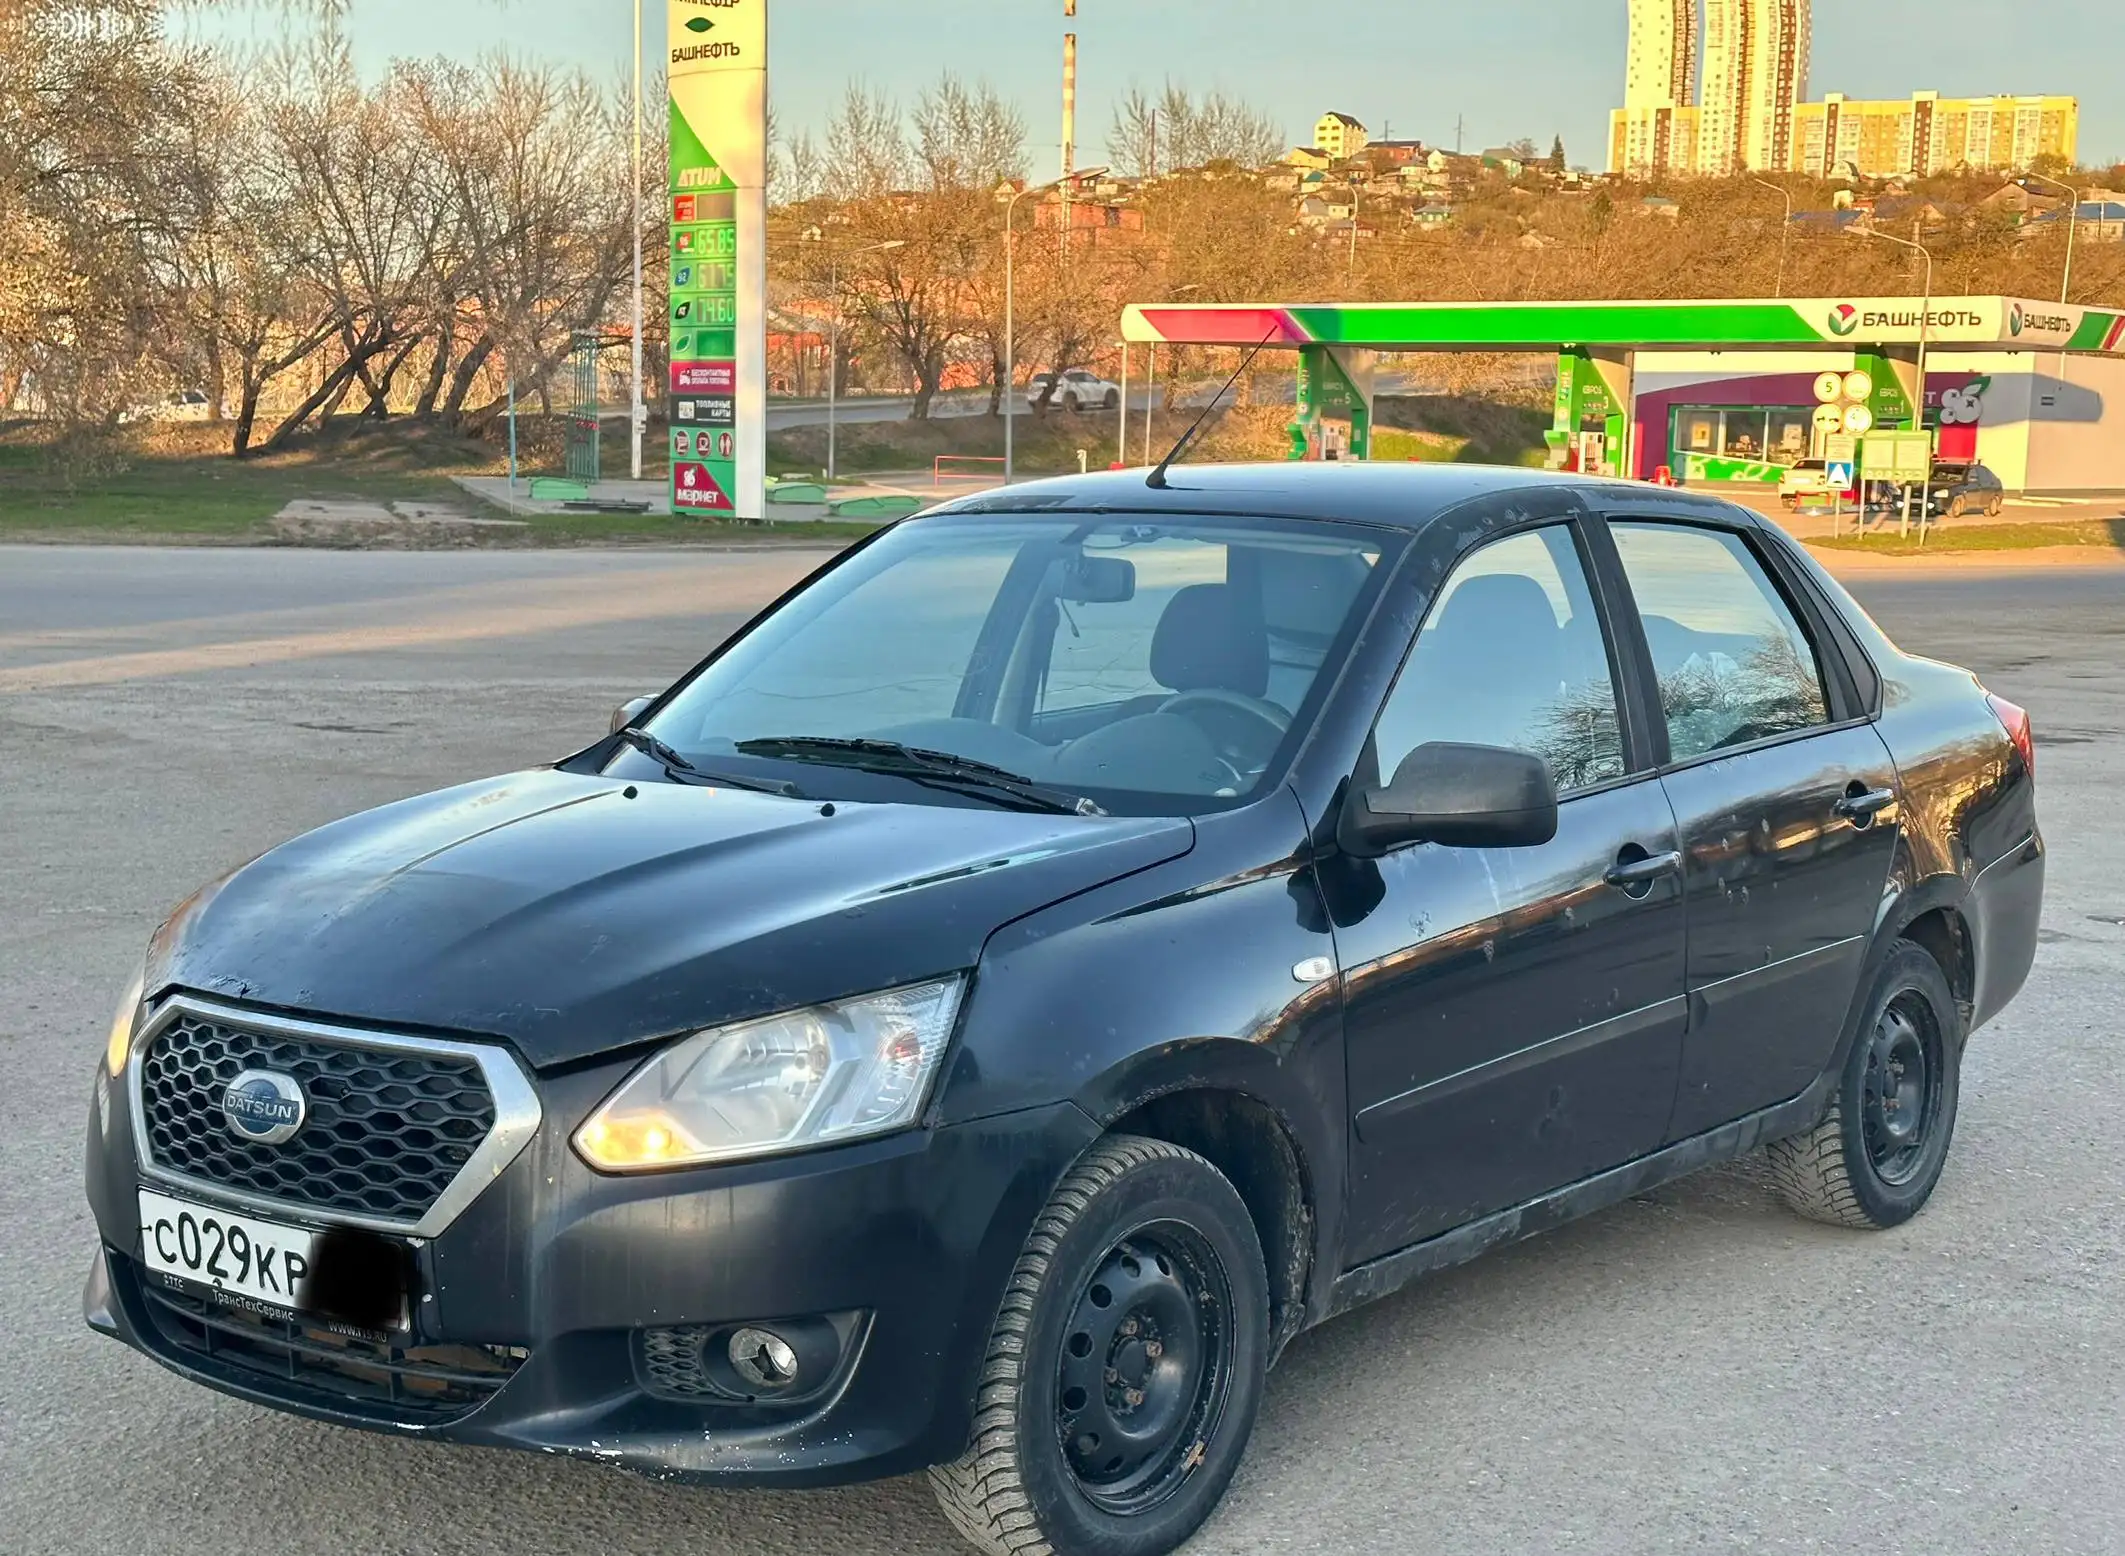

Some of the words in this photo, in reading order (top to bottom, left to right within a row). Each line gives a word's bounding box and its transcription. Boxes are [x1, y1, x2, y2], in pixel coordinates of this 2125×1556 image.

[671, 42, 740, 63] БАШНЕФТЬ
[1862, 310, 1982, 327] БАШНЕФТЬ
[2024, 313, 2071, 332] БАШНЕФТЬ
[1825, 381, 1833, 393] 5
[227, 1095, 292, 1119] DATSUN
[154, 1211, 309, 1296] С029КР
[212, 1290, 295, 1322] ТрансТехСервис
